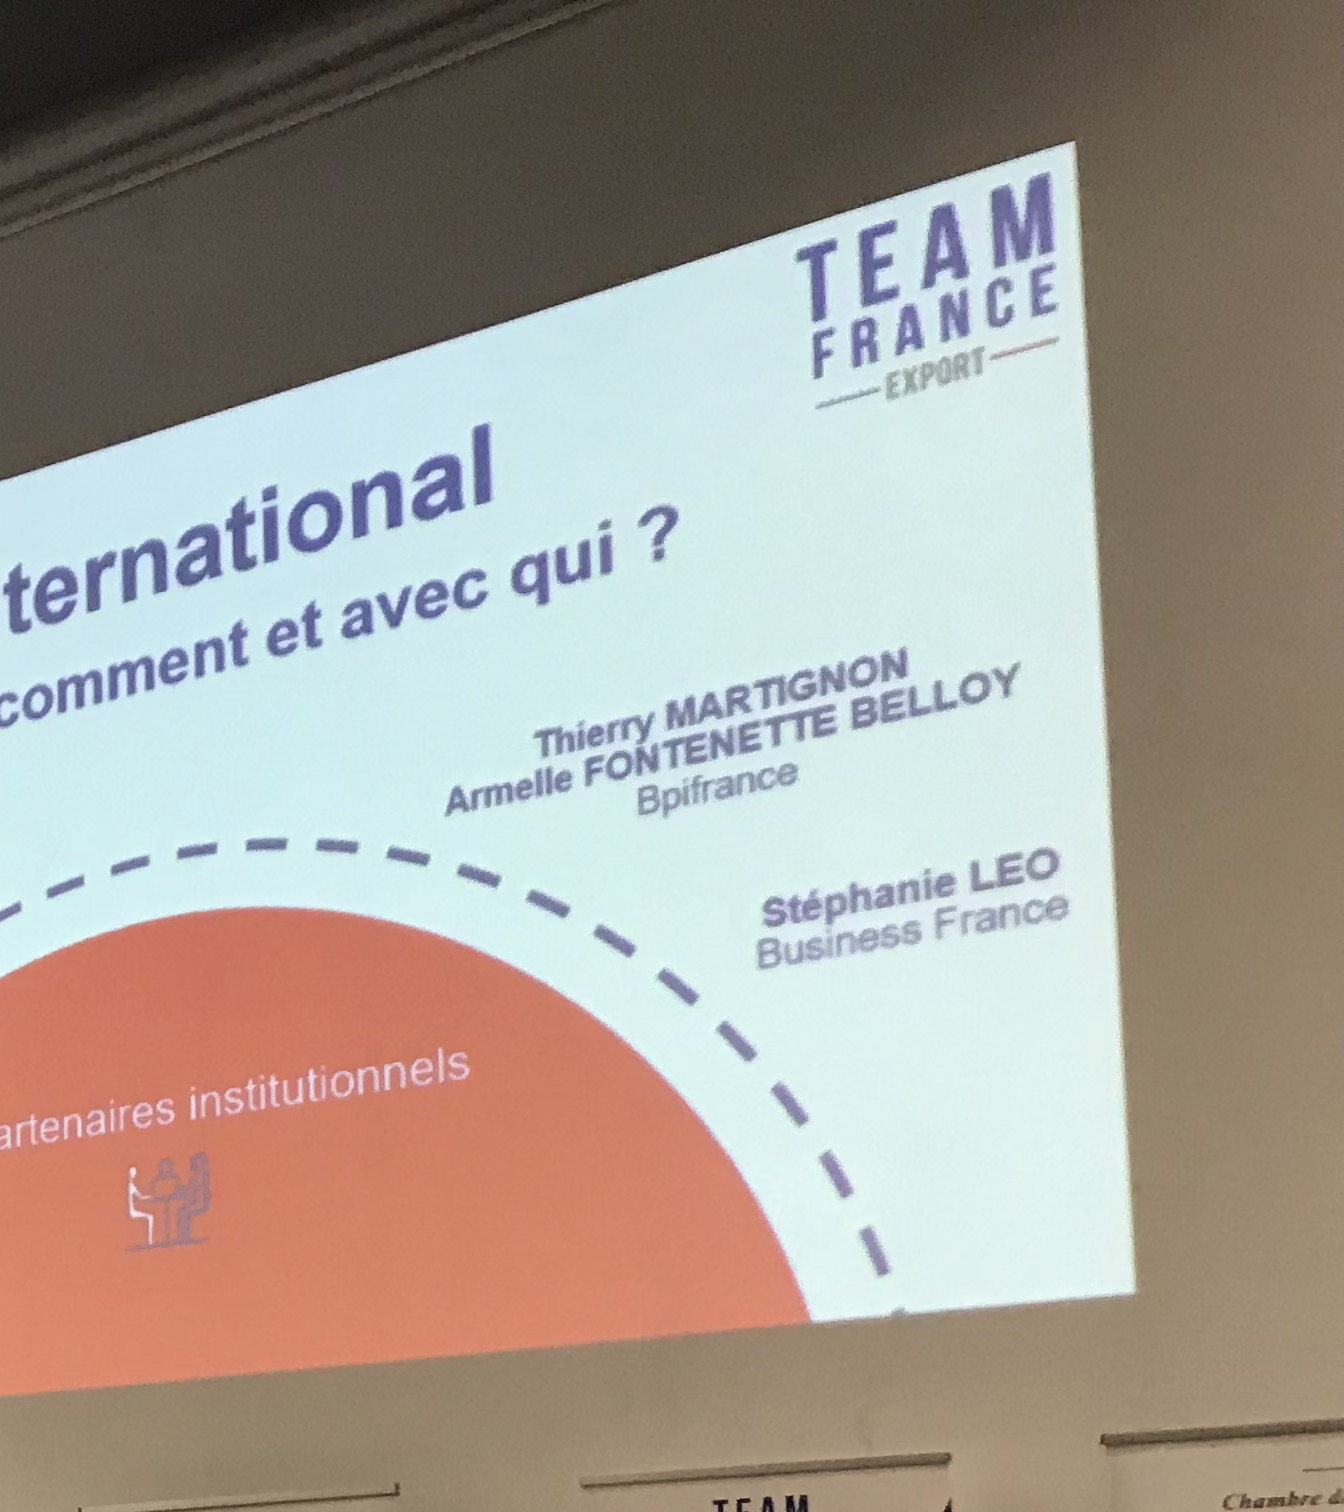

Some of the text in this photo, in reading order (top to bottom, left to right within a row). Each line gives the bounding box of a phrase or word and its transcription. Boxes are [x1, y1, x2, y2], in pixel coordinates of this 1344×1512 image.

[796, 171, 1055, 322] TEAM
[813, 262, 1058, 380] FRANCE
[885, 346, 985, 400] EXPORT
[266, 605, 323, 658] et
[341, 570, 488, 643] avec
[510, 521, 615, 607] qui
[638, 505, 681, 562] ?
[445, 662, 1021, 816] Armelle FONTENETTE BELLOY
[533, 647, 909, 758] Thierry MARTIGNON
[637, 761, 800, 817] Bpifrance
[762, 847, 1060, 928] Stéphanie LEO
[756, 894, 1070, 970] Business France
[189, 1046, 470, 1121] institutionnels
[1222, 1488, 1344, 1511] Chambre d
